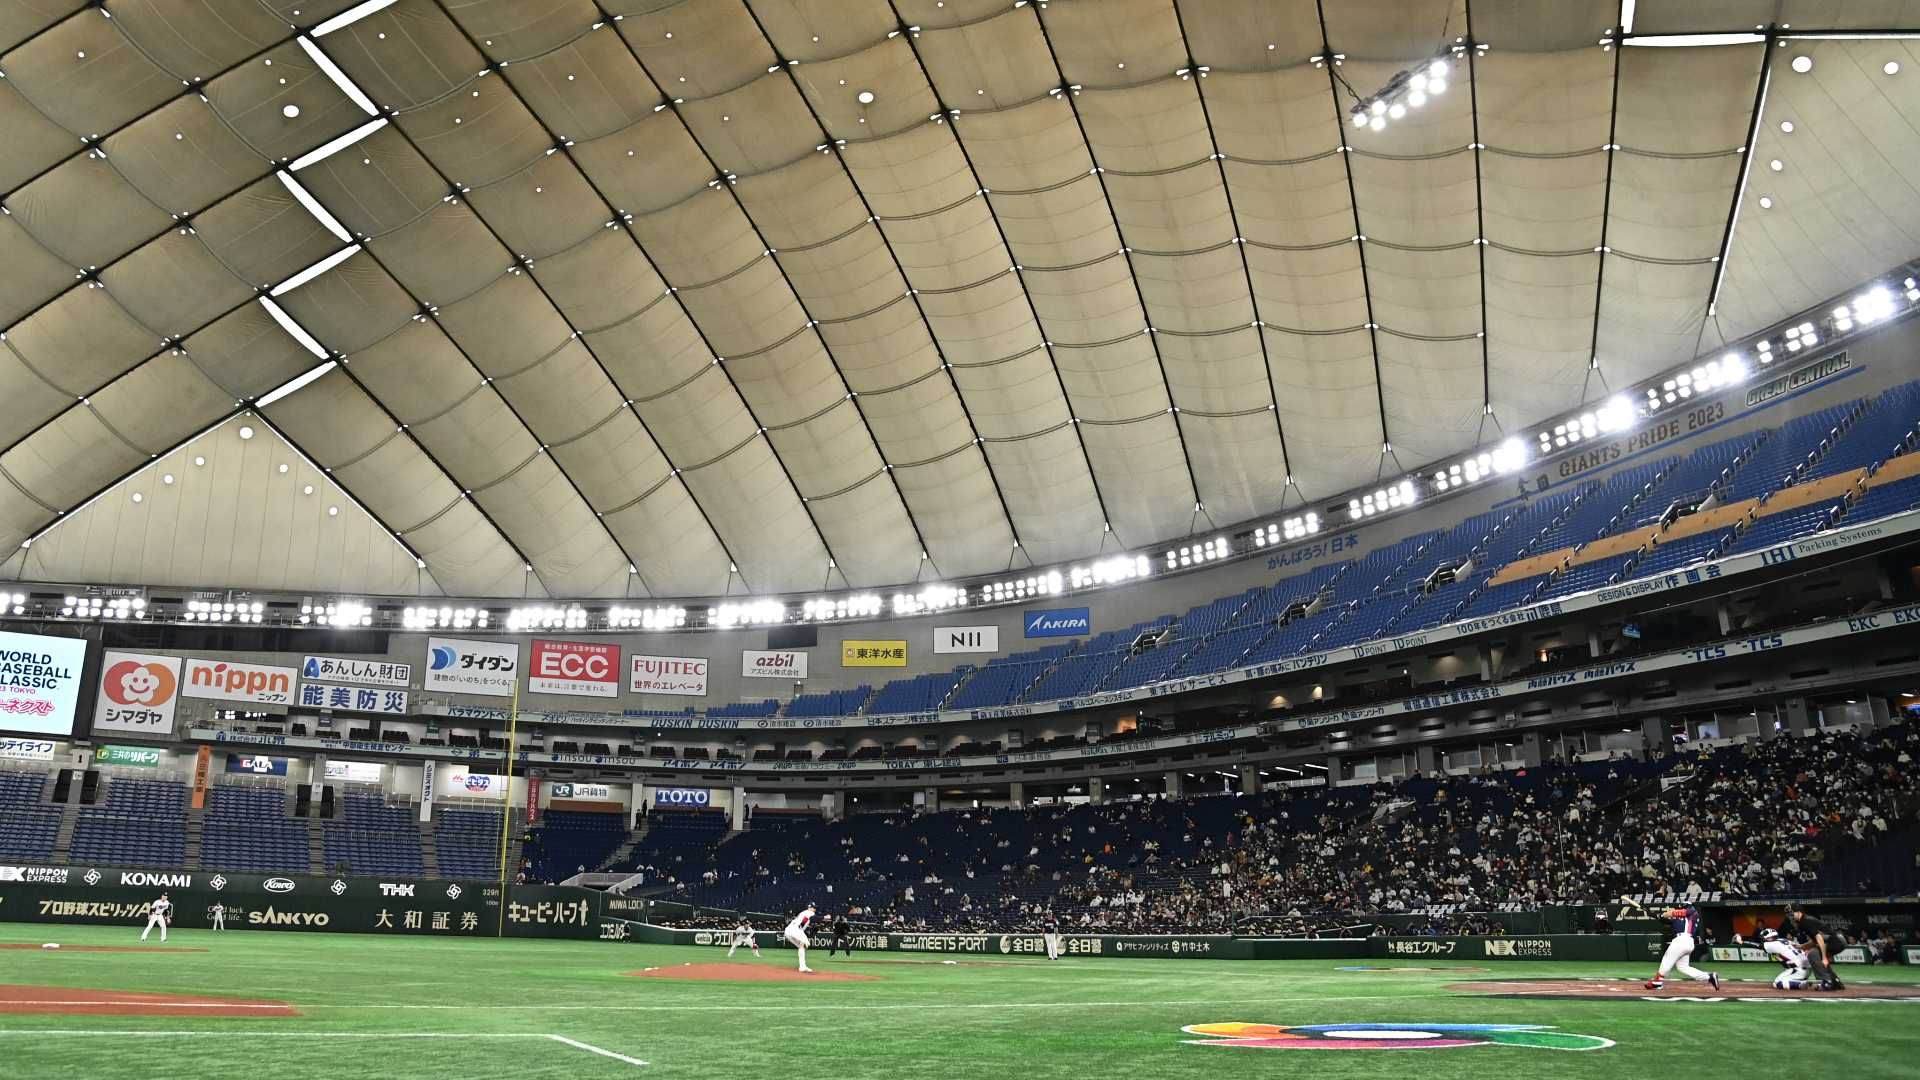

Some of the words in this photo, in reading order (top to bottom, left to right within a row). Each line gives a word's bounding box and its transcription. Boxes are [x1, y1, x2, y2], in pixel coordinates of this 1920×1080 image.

[1560, 442, 1621, 477] GIANTS
[1628, 420, 1679, 453] PRIDE
[1688, 402, 1724, 430] 2023
[1760, 545, 1797, 566] IHI
[1798, 538, 1838, 553] Parking
[1839, 527, 1883, 545] Systems
[1042, 618, 1087, 629] AKIRA
[1848, 615, 1880, 632] EKC
[1406, 636, 1428, 648] POINT
[1695, 645, 1726, 661] TCS
[1747, 634, 1783, 651] TCS
[857, 648, 905, 659] 東洋水産
[1365, 645, 1387, 655] POINT
[0, 650, 52, 665] WORLD
[460, 653, 514, 672] ダイダン
[756, 653, 795, 667] azbil
[0, 662, 72, 679] ASEBALL
[320, 659, 409, 681] あんしん財団
[540, 651, 609, 679] ECC
[634, 659, 706, 679] FUJITEC
[0, 674, 58, 690] LASSIC
[191, 663, 289, 695] nippn
[634, 680, 703, 691] 世界のエレベータ
[10, 686, 36, 694] TOKYO
[257, 692, 288, 702] ニップン
[303, 685, 403, 712] 能美防災
[105, 707, 163, 725] シマダヤ
[651, 719, 693, 728] DUSKIN
[698, 719, 740, 728] DUSKIN
[886, 761, 915, 769] TORAY
[556, 785, 570, 795] JR
[575, 787, 608, 797] JR貨物
[658, 789, 708, 804] TOTO
[27, 875, 68, 883] EXPRESS
[28, 867, 69, 877] NIPPON
[121, 872, 192, 887] KONAMI
[266, 879, 294, 890] Kowa
[380, 883, 415, 897] THK
[609, 899, 627, 910] MIWA
[248, 905, 329, 926] SANKYO
[374, 908, 479, 930] 大和証券
[508, 901, 577, 923] キューピーハーフ
[713, 932, 734, 946] ウエル
[918, 936, 956, 950] MEETS
[958, 936, 988, 951] PORT
[1012, 937, 1045, 952] 全日警
[1068, 938, 1102, 953] 全日警
[1517, 940, 1551, 949] NIPPON
[1181, 941, 1210, 952] 竹中土木
[1396, 941, 1457, 954] 長谷工グループ
[1518, 948, 1552, 956] EXPRESS
